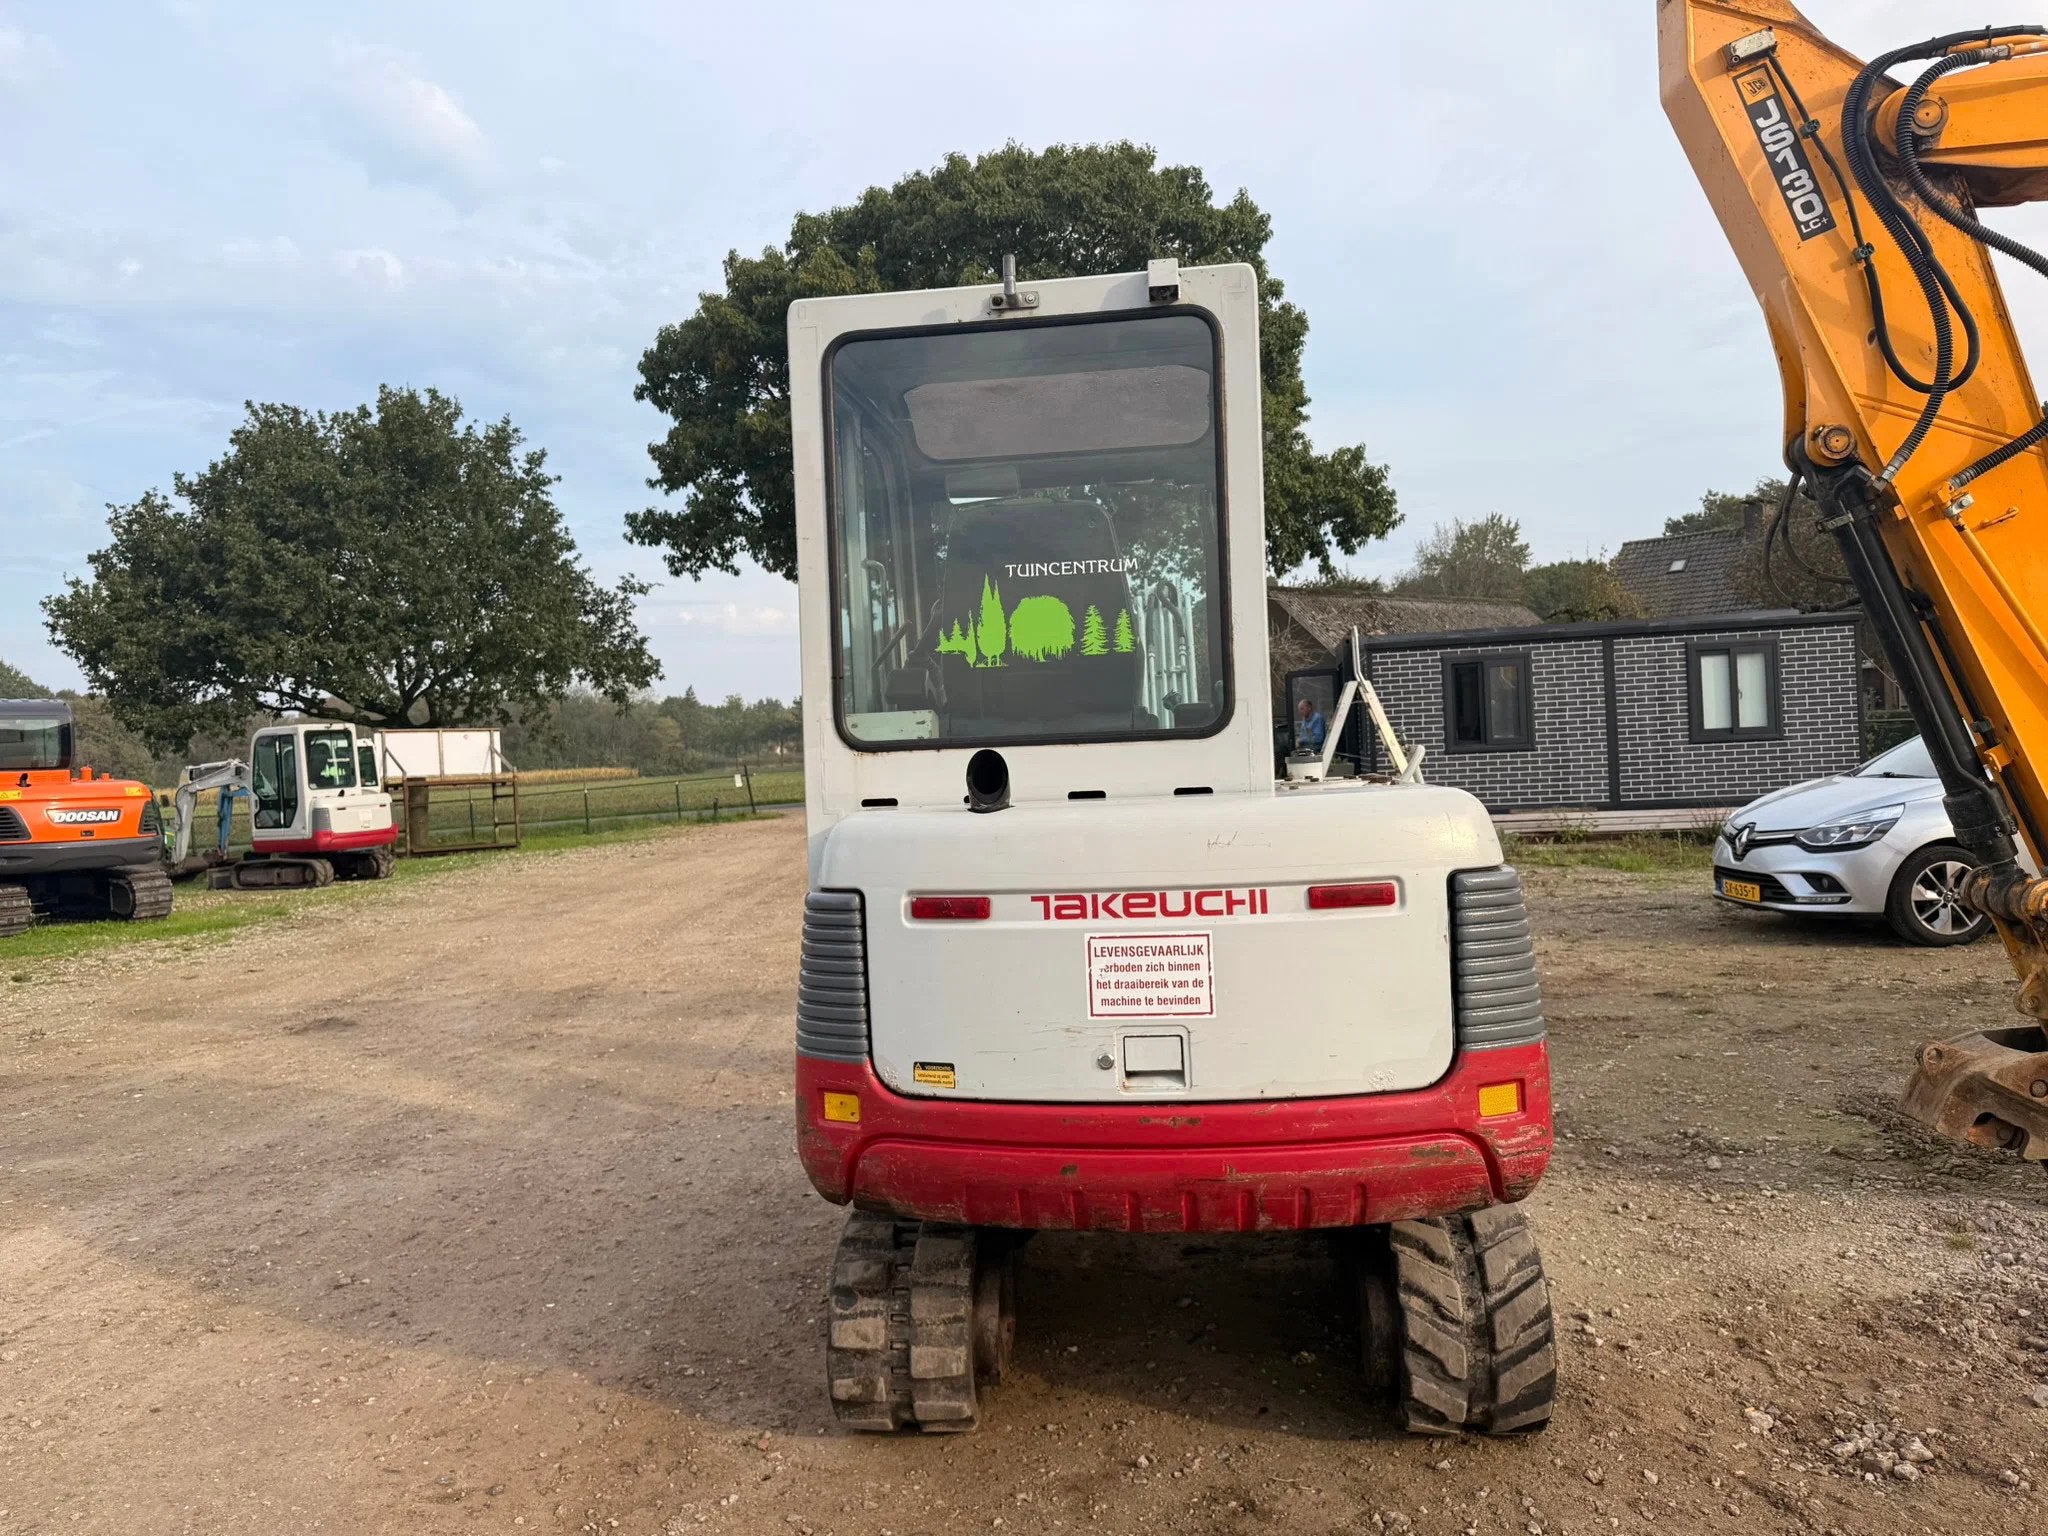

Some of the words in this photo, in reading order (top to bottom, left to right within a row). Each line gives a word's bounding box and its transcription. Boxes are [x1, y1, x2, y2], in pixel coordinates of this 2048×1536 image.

[1747, 78, 1766, 94] JCB
[1756, 98, 1824, 223] JS130
[1801, 216, 1829, 234] LC+
[1005, 558, 1138, 578] TUINCENTRUM
[53, 810, 119, 823] DOOSAN
[1031, 888, 1268, 920] TAKEUCHI
[1094, 945, 1204, 958] LEVENSGEVAARLIJK
[1145, 962, 1165, 972] zich
[1168, 961, 1201, 972] binnen
[1096, 979, 1112, 990] het
[1114, 978, 1169, 990] draaibereik
[1172, 979, 1189, 989] van
[1192, 978, 1204, 988] de
[1101, 996, 1142, 1007] machine
[1145, 996, 1154, 1006] te
[1157, 995, 1201, 1006] bevinden
